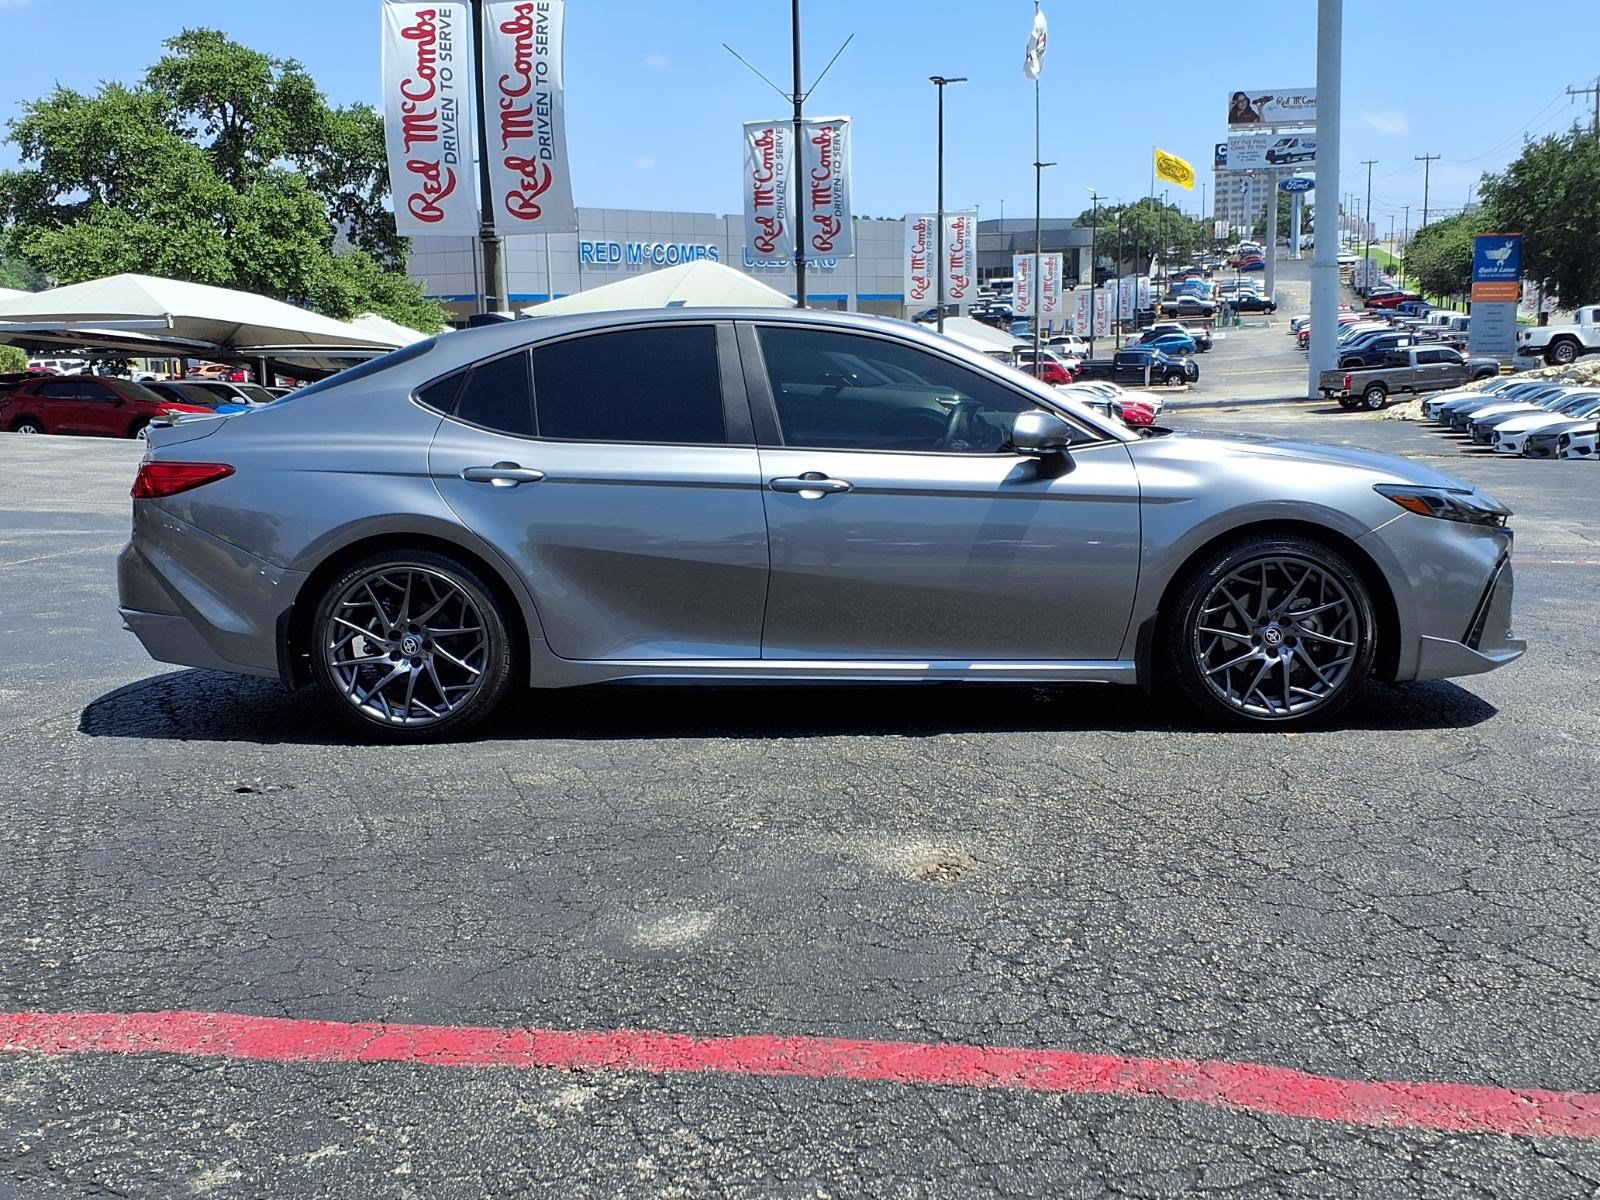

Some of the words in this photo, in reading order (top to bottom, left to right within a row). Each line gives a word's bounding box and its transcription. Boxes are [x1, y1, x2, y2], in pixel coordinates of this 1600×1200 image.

[439, 9, 452, 62] SERVE
[536, 2, 550, 56] SERVE
[400, 9, 438, 154] McCombs
[440, 67, 453, 92] TO
[499, 2, 535, 151] McCombs
[536, 61, 549, 87] TO
[1276, 96, 1290, 108] Red
[1291, 96, 1316, 105] McCom
[440, 98, 457, 165] DRIVEN
[536, 92, 553, 161] DRIVEN
[775, 127, 784, 160] SERVE
[833, 126, 841, 160] SERVE
[753, 128, 774, 213] McCombs
[775, 163, 784, 178] TO
[811, 126, 832, 211] McCombs
[833, 160, 841, 178] TO
[1286, 179, 1310, 190] Ford
[406, 160, 457, 223] Red
[504, 155, 552, 220] Red
[775, 180, 785, 220] DRIVEN
[833, 178, 843, 217] DRIVEN
[754, 216, 783, 253] Red
[811, 215, 841, 252] Red
[911, 218, 926, 274] McCombs
[926, 240, 932, 251] TO
[949, 216, 965, 272] McCombs
[580, 241, 622, 264] RED
[626, 242, 720, 265] McCOMBS
[910, 275, 930, 300] Red
[949, 274, 969, 299] Red
[1043, 256, 1054, 294] McCombs
[1016, 296, 1030, 313] Red
[1043, 295, 1057, 312] Red
